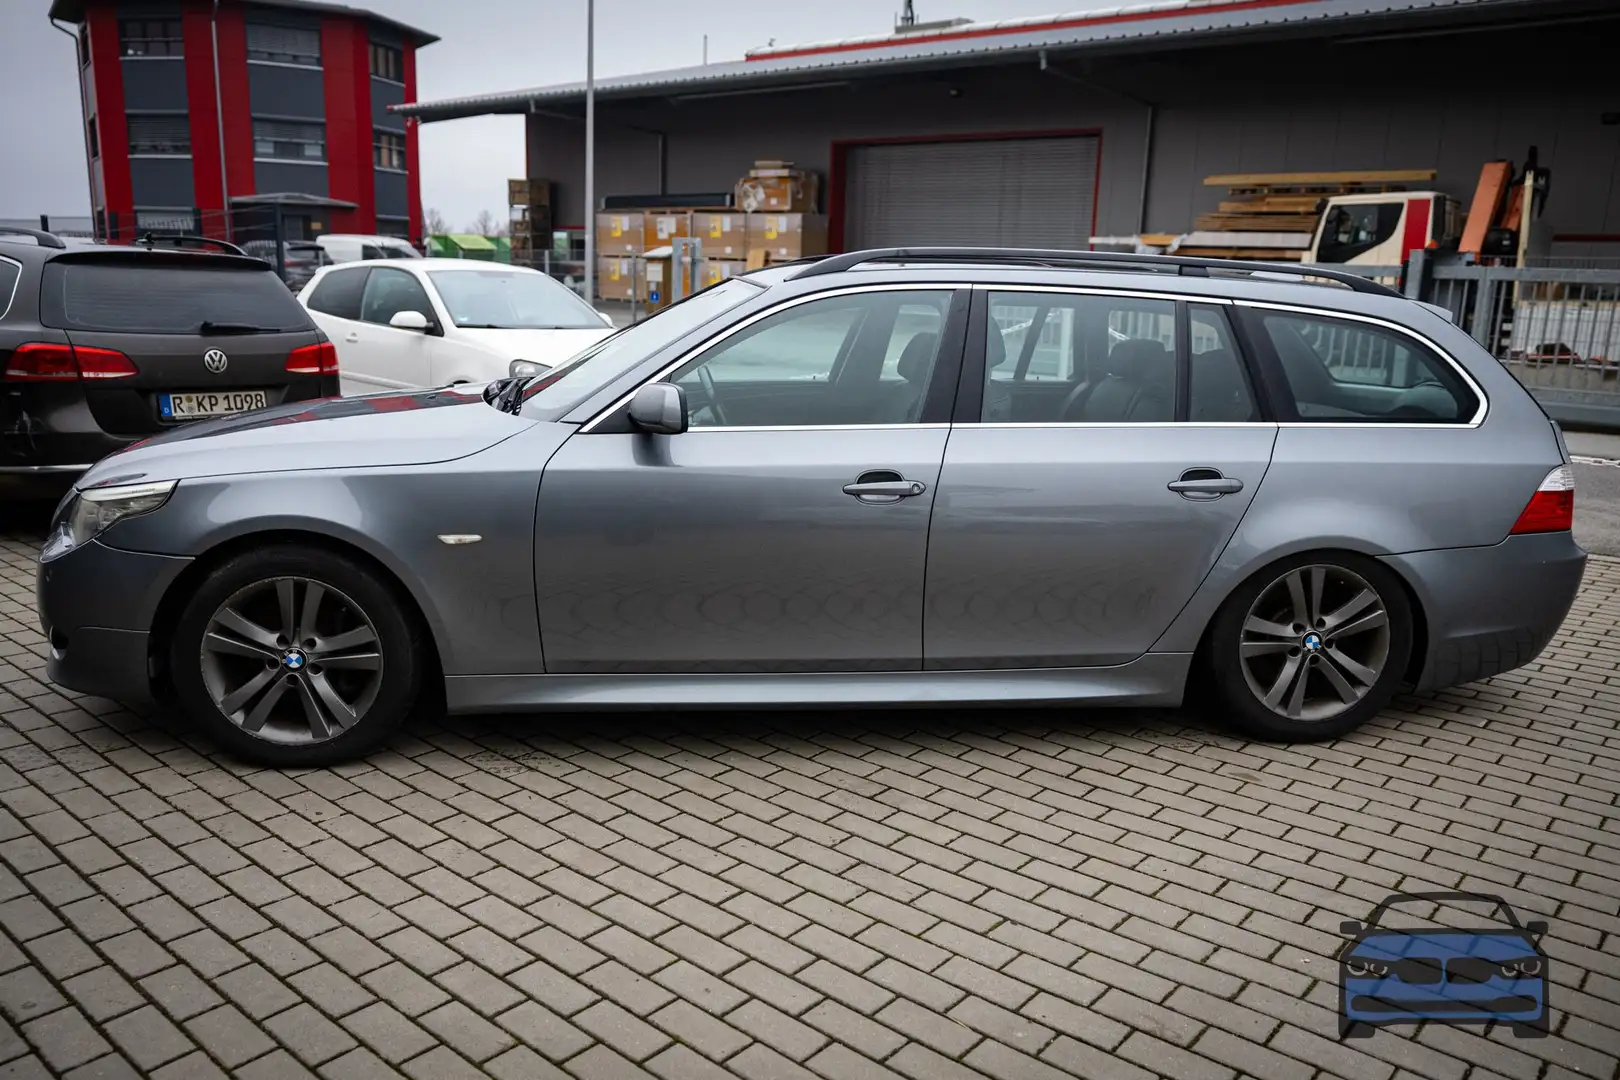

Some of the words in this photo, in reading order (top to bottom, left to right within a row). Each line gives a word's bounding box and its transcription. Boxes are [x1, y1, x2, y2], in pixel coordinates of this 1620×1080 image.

[205, 350, 228, 373] VW
[173, 396, 184, 413] R
[196, 395, 218, 412] KP
[223, 394, 264, 411] 1098
